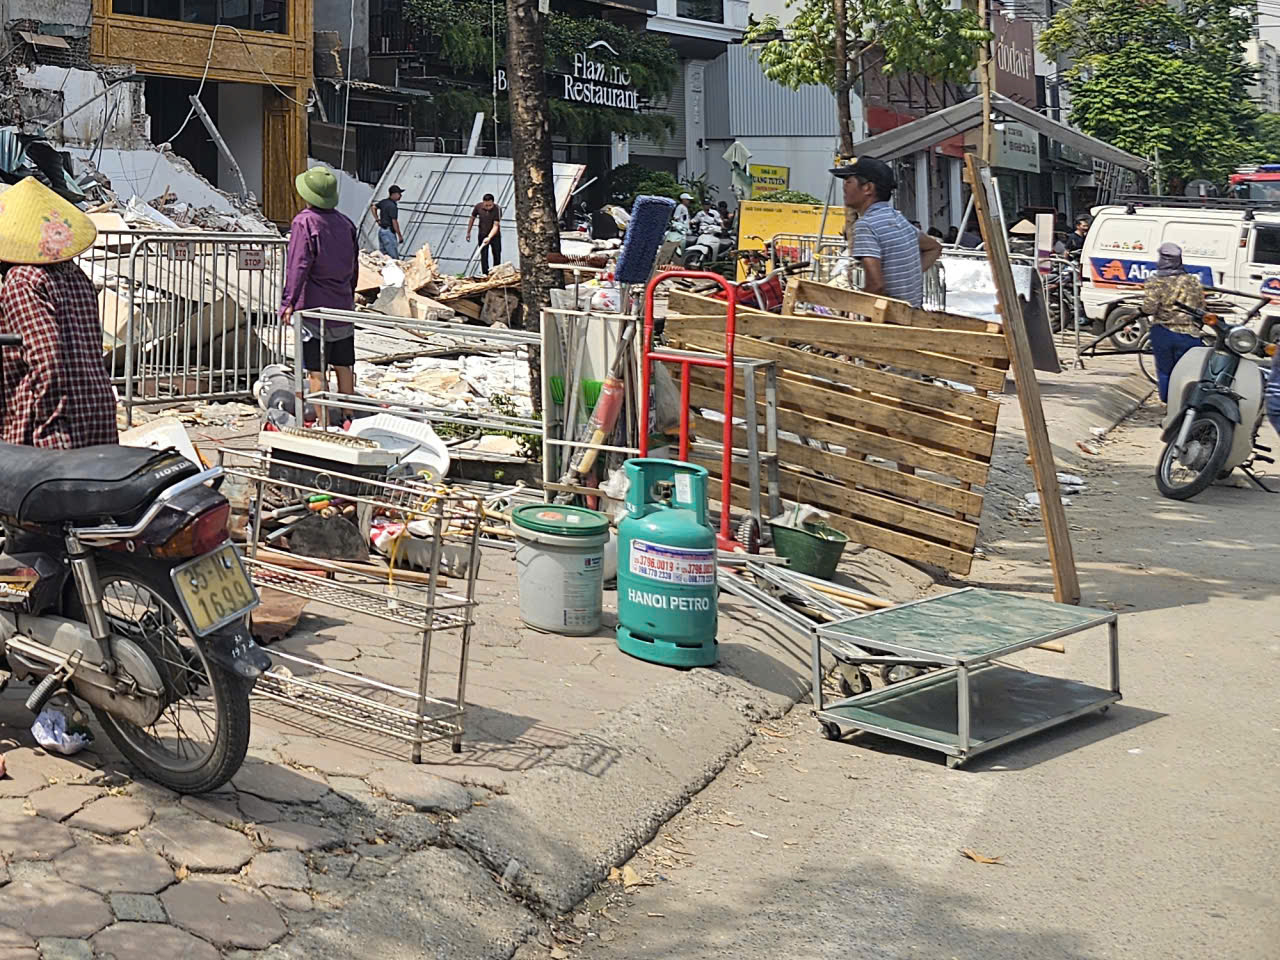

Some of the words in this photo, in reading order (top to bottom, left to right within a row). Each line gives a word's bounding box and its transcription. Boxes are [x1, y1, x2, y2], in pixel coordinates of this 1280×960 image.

[563, 73, 640, 110] Restaurant
[175, 248, 187, 258] STO
[244, 258, 261, 267] STOP
[628, 587, 668, 609] HANOI
[669, 596, 710, 611] PETRO
